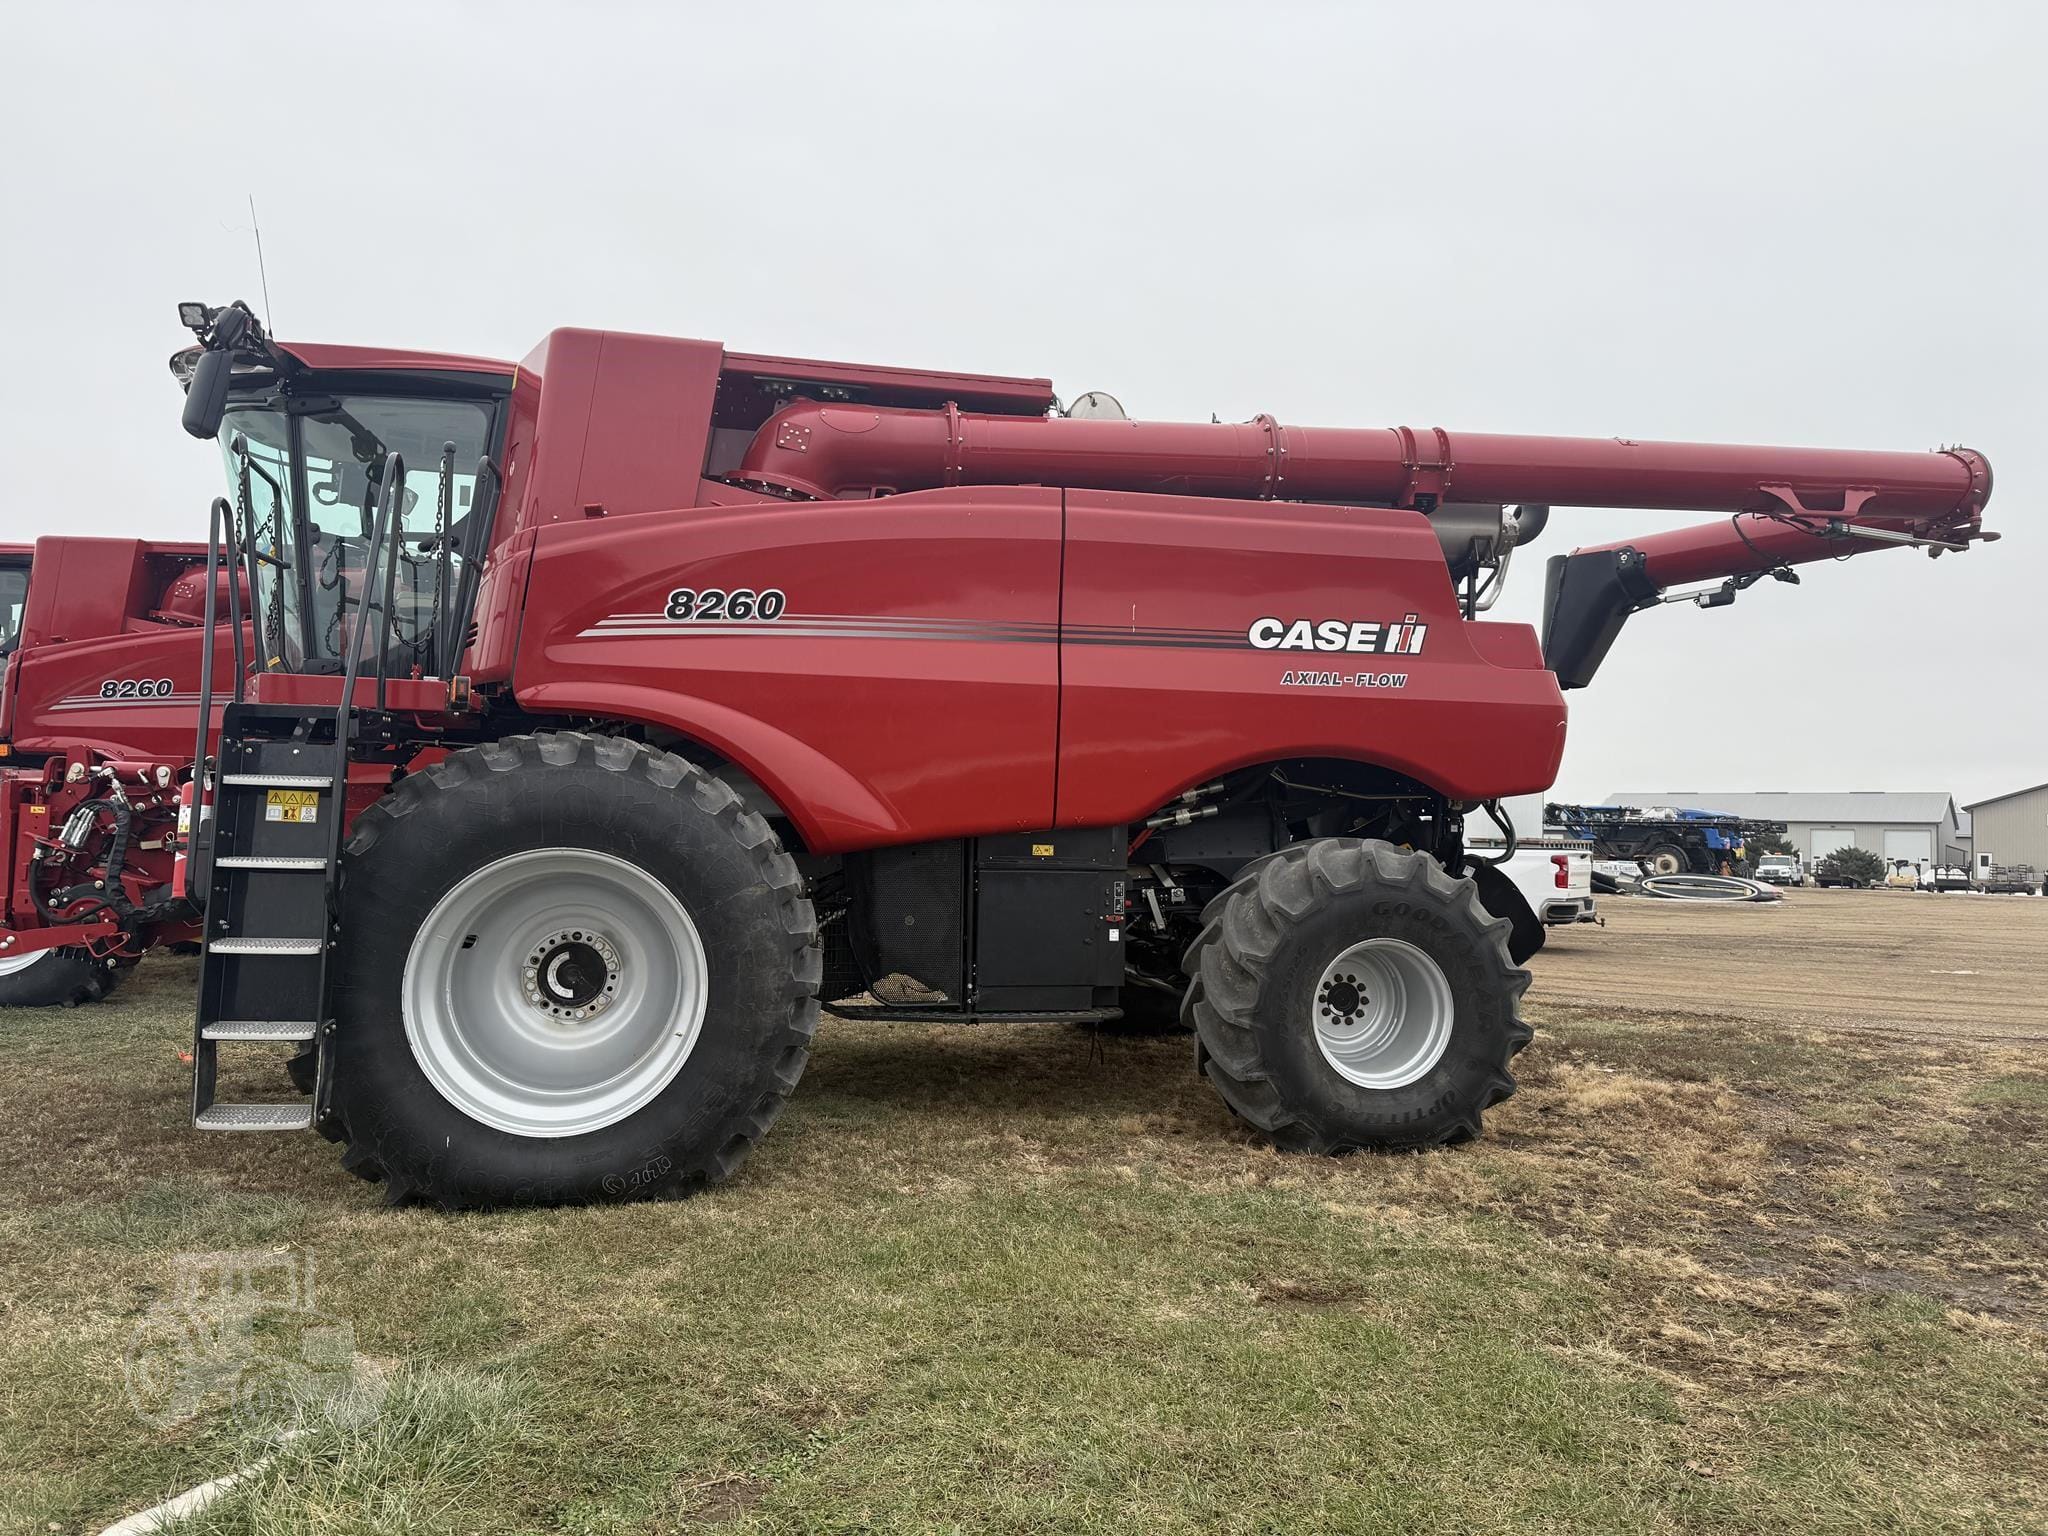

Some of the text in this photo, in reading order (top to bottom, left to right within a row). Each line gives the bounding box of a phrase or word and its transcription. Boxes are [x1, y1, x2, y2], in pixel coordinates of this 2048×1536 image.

[664, 588, 786, 621] 8260
[1248, 617, 1381, 652] CASE
[100, 678, 173, 699] 8260
[1280, 671, 1408, 688] AXIAL-FLOW
